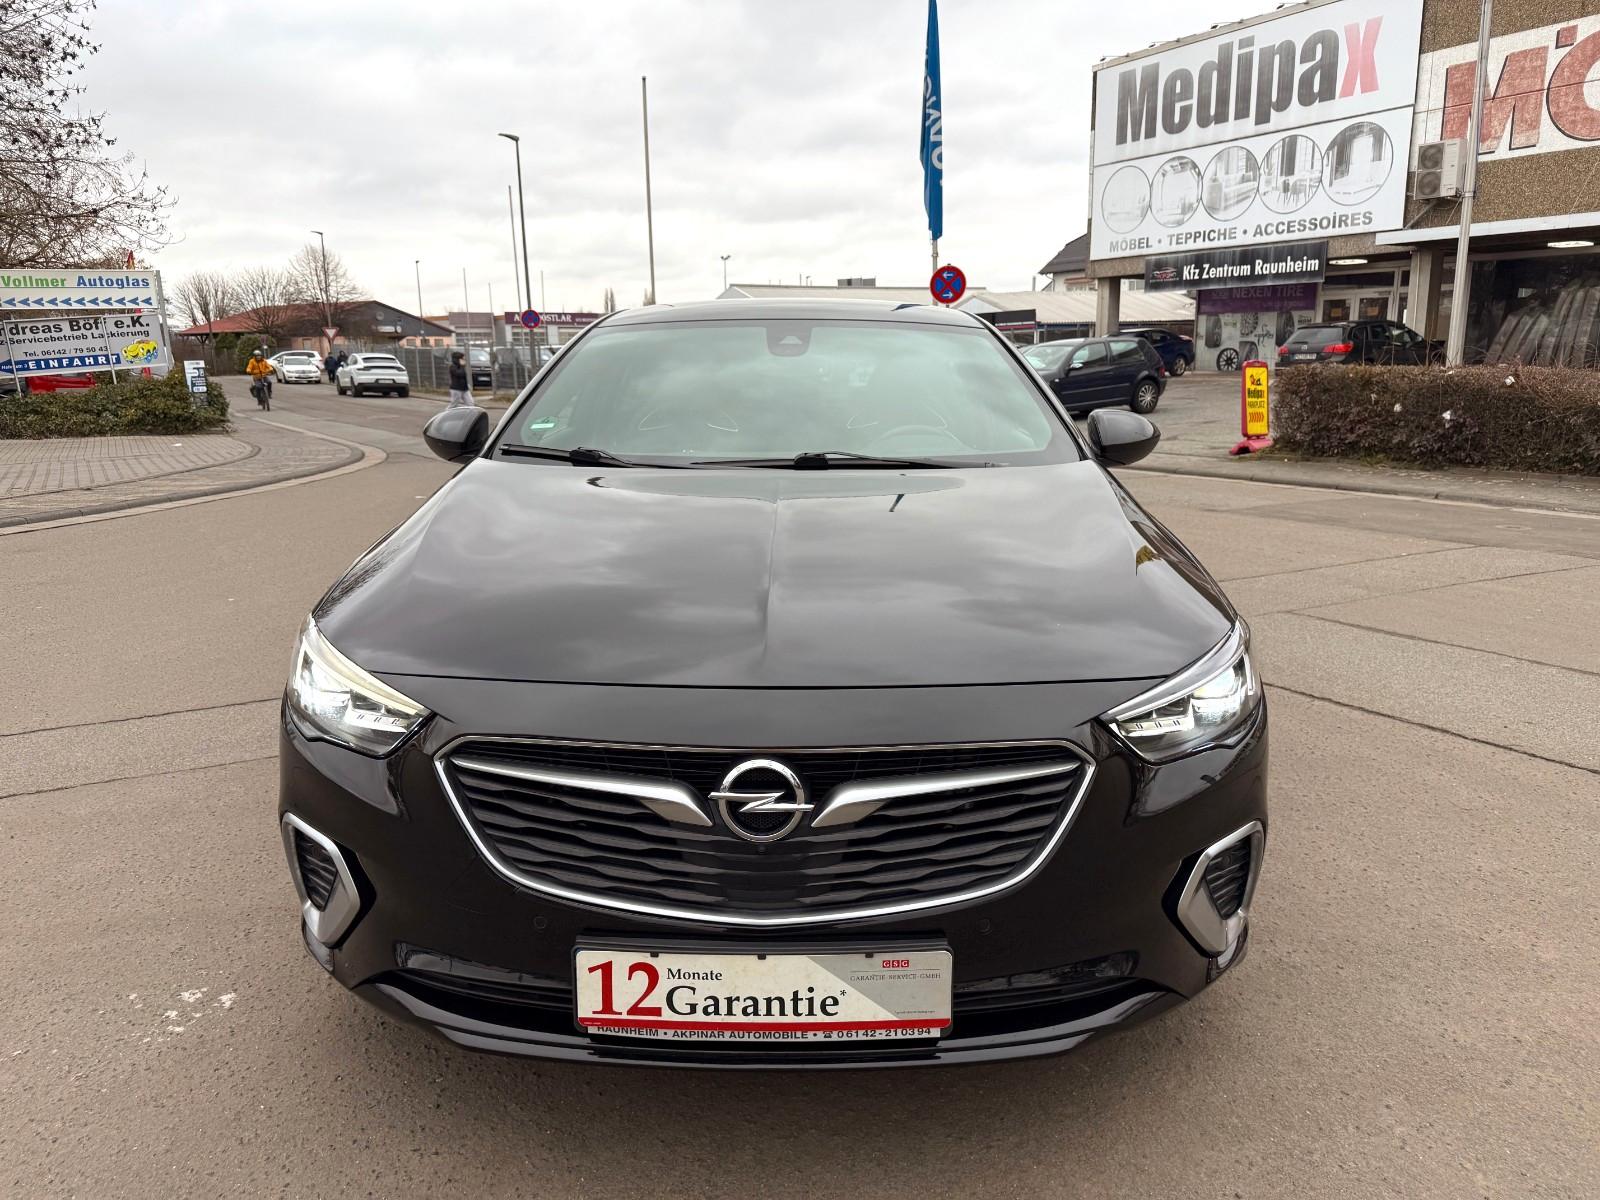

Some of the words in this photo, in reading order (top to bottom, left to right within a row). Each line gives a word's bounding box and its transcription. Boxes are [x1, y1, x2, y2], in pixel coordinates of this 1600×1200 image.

[1116, 15, 1384, 146] Medipax
[1167, 227, 1237, 247] TEPPICHE
[1183, 264, 1200, 280] Kfz
[1202, 262, 1251, 279] Zentrum
[1254, 257, 1320, 276] Raunheim
[1, 275, 66, 287] Vollmer
[77, 275, 150, 289] Autoglas
[1232, 288, 1272, 299] NEXEN
[1276, 285, 1304, 297] TIRE
[114, 316, 150, 329] e.K.
[28, 355, 118, 370] EINFAHRT
[666, 968, 723, 981] Monate
[587, 960, 662, 1017] 12
[672, 1030, 725, 1039] AKPINAR
[728, 1030, 808, 1039] AUTOMOBILE
